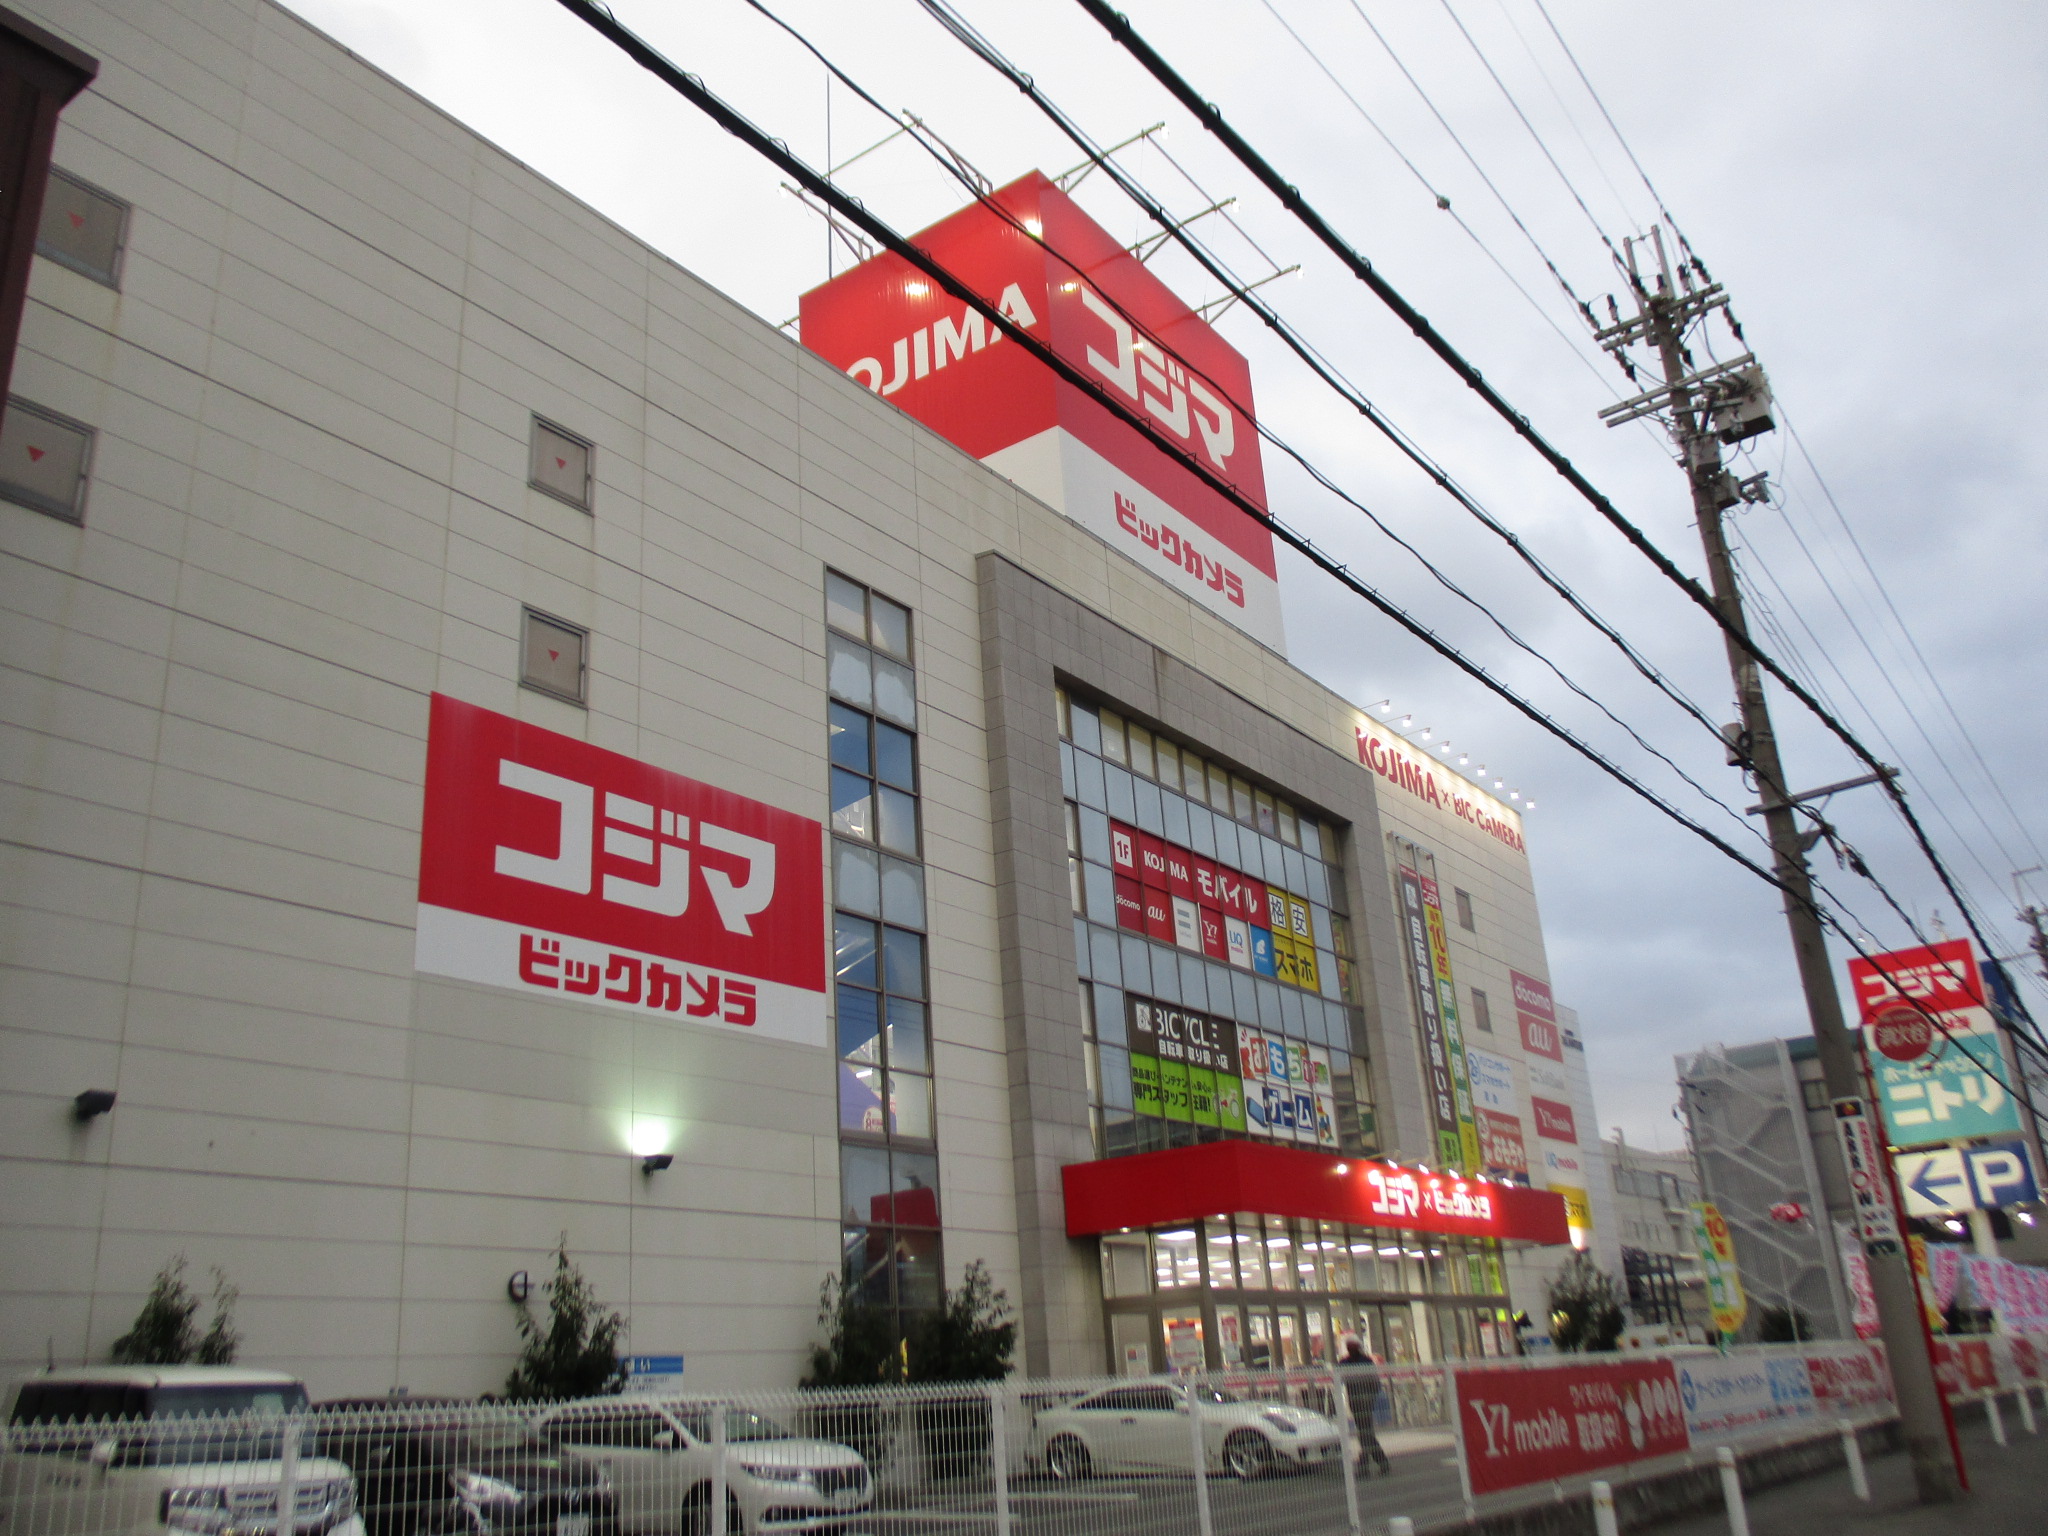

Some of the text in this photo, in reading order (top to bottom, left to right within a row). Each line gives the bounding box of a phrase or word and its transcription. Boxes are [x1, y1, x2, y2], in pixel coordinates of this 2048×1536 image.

[846, 282, 1037, 396] OJIMA
[1081, 285, 1235, 472] コジマ
[1113, 490, 1245, 609] ビックカメラ
[1355, 726, 1442, 810] KOJIMA
[1452, 792, 1475, 825] BIC
[1475, 807, 1526, 855] CAMERA
[494, 758, 776, 937] コジマ
[1116, 839, 1130, 860] 1F
[1116, 894, 1141, 911] docomo
[1144, 850, 1258, 914] KOJMA モバイル
[1147, 905, 1166, 922] au
[1271, 896, 1307, 937] 格安
[1229, 930, 1243, 947] UQ
[518, 932, 757, 1027] ビックカメラ
[1275, 947, 1314, 982] スマホ
[1860, 959, 1967, 1006] コジマ
[1251, 1039, 1316, 1083] おもちゃ
[1265, 1090, 1314, 1128] ゲーム
[1887, 1073, 2006, 1127] ニトリ
[1368, 1172, 1420, 1219] コジマ
[1433, 1184, 1492, 1221] ビックカメラ
[1968, 1149, 2025, 1205] P
